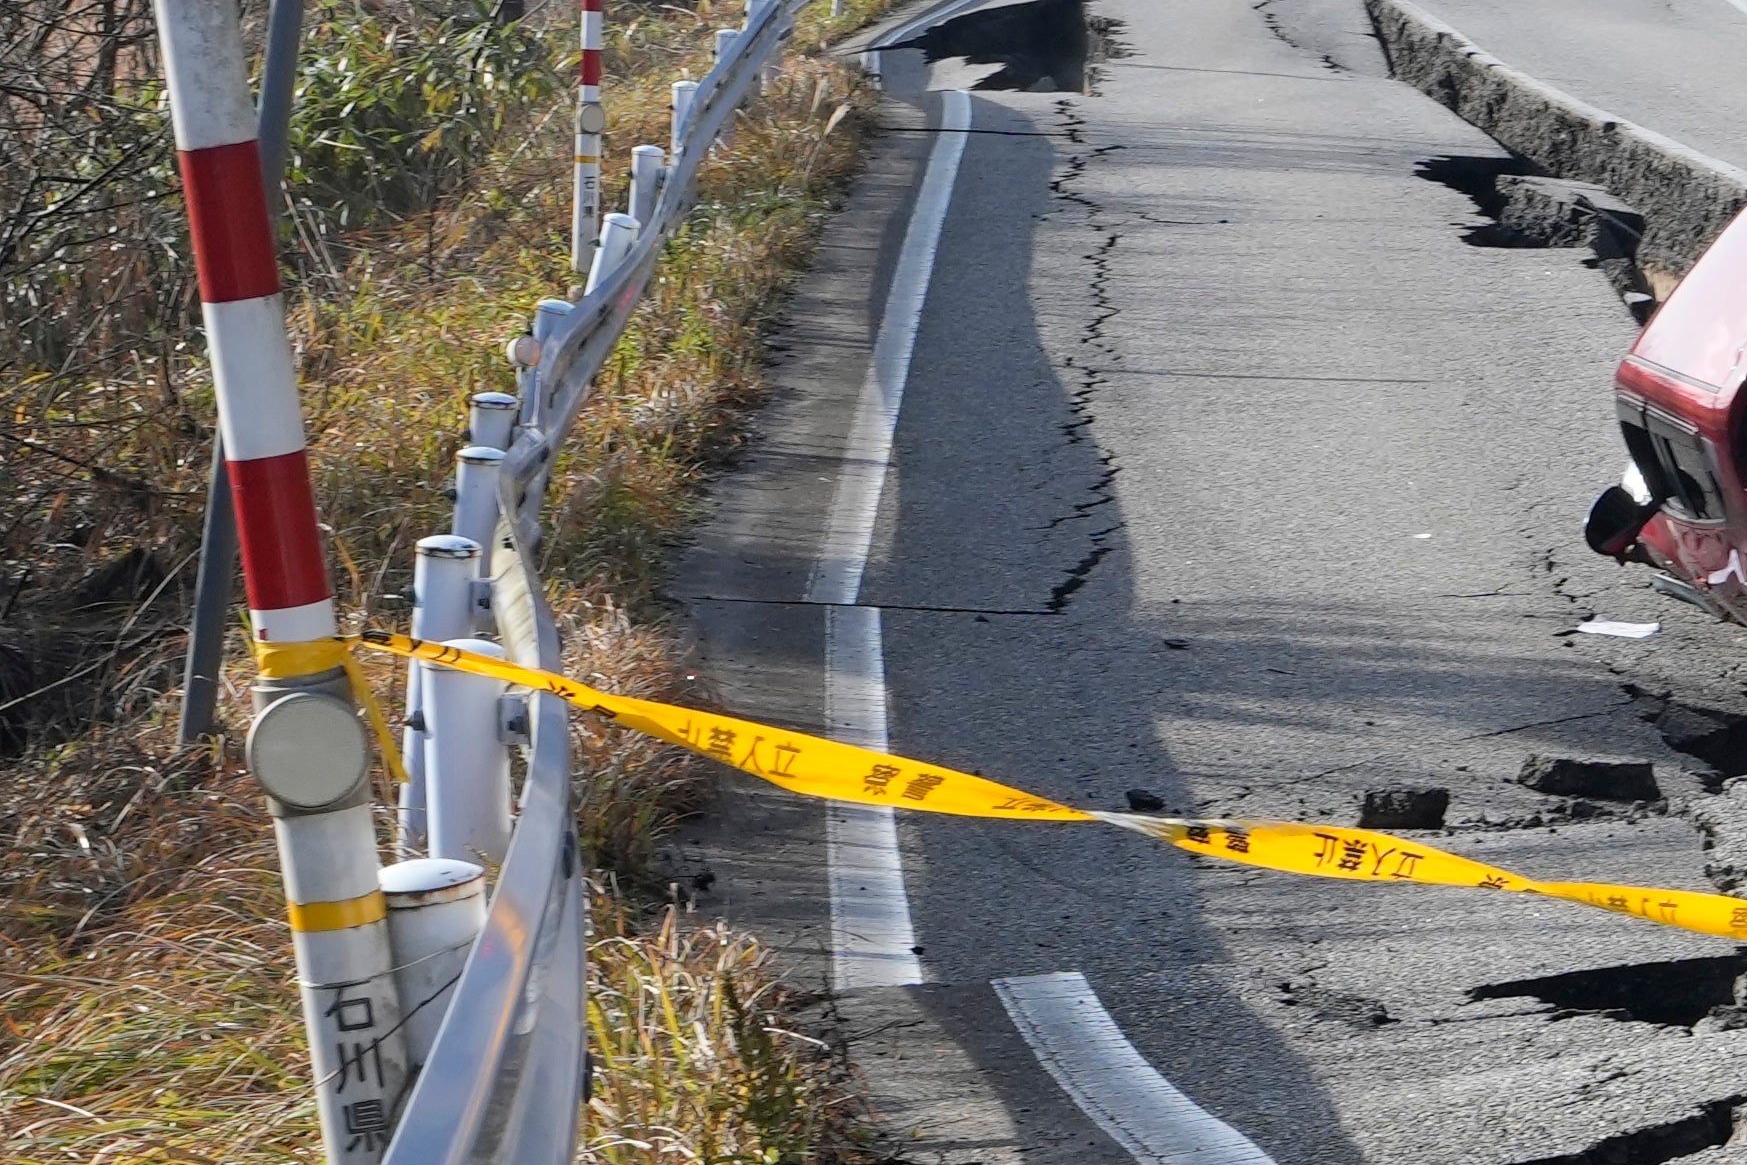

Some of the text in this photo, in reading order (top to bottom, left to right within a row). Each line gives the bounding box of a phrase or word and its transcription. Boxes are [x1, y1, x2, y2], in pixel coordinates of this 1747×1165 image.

[1313, 832, 1424, 879] 立入禁止
[323, 984, 390, 1153] 石川県
